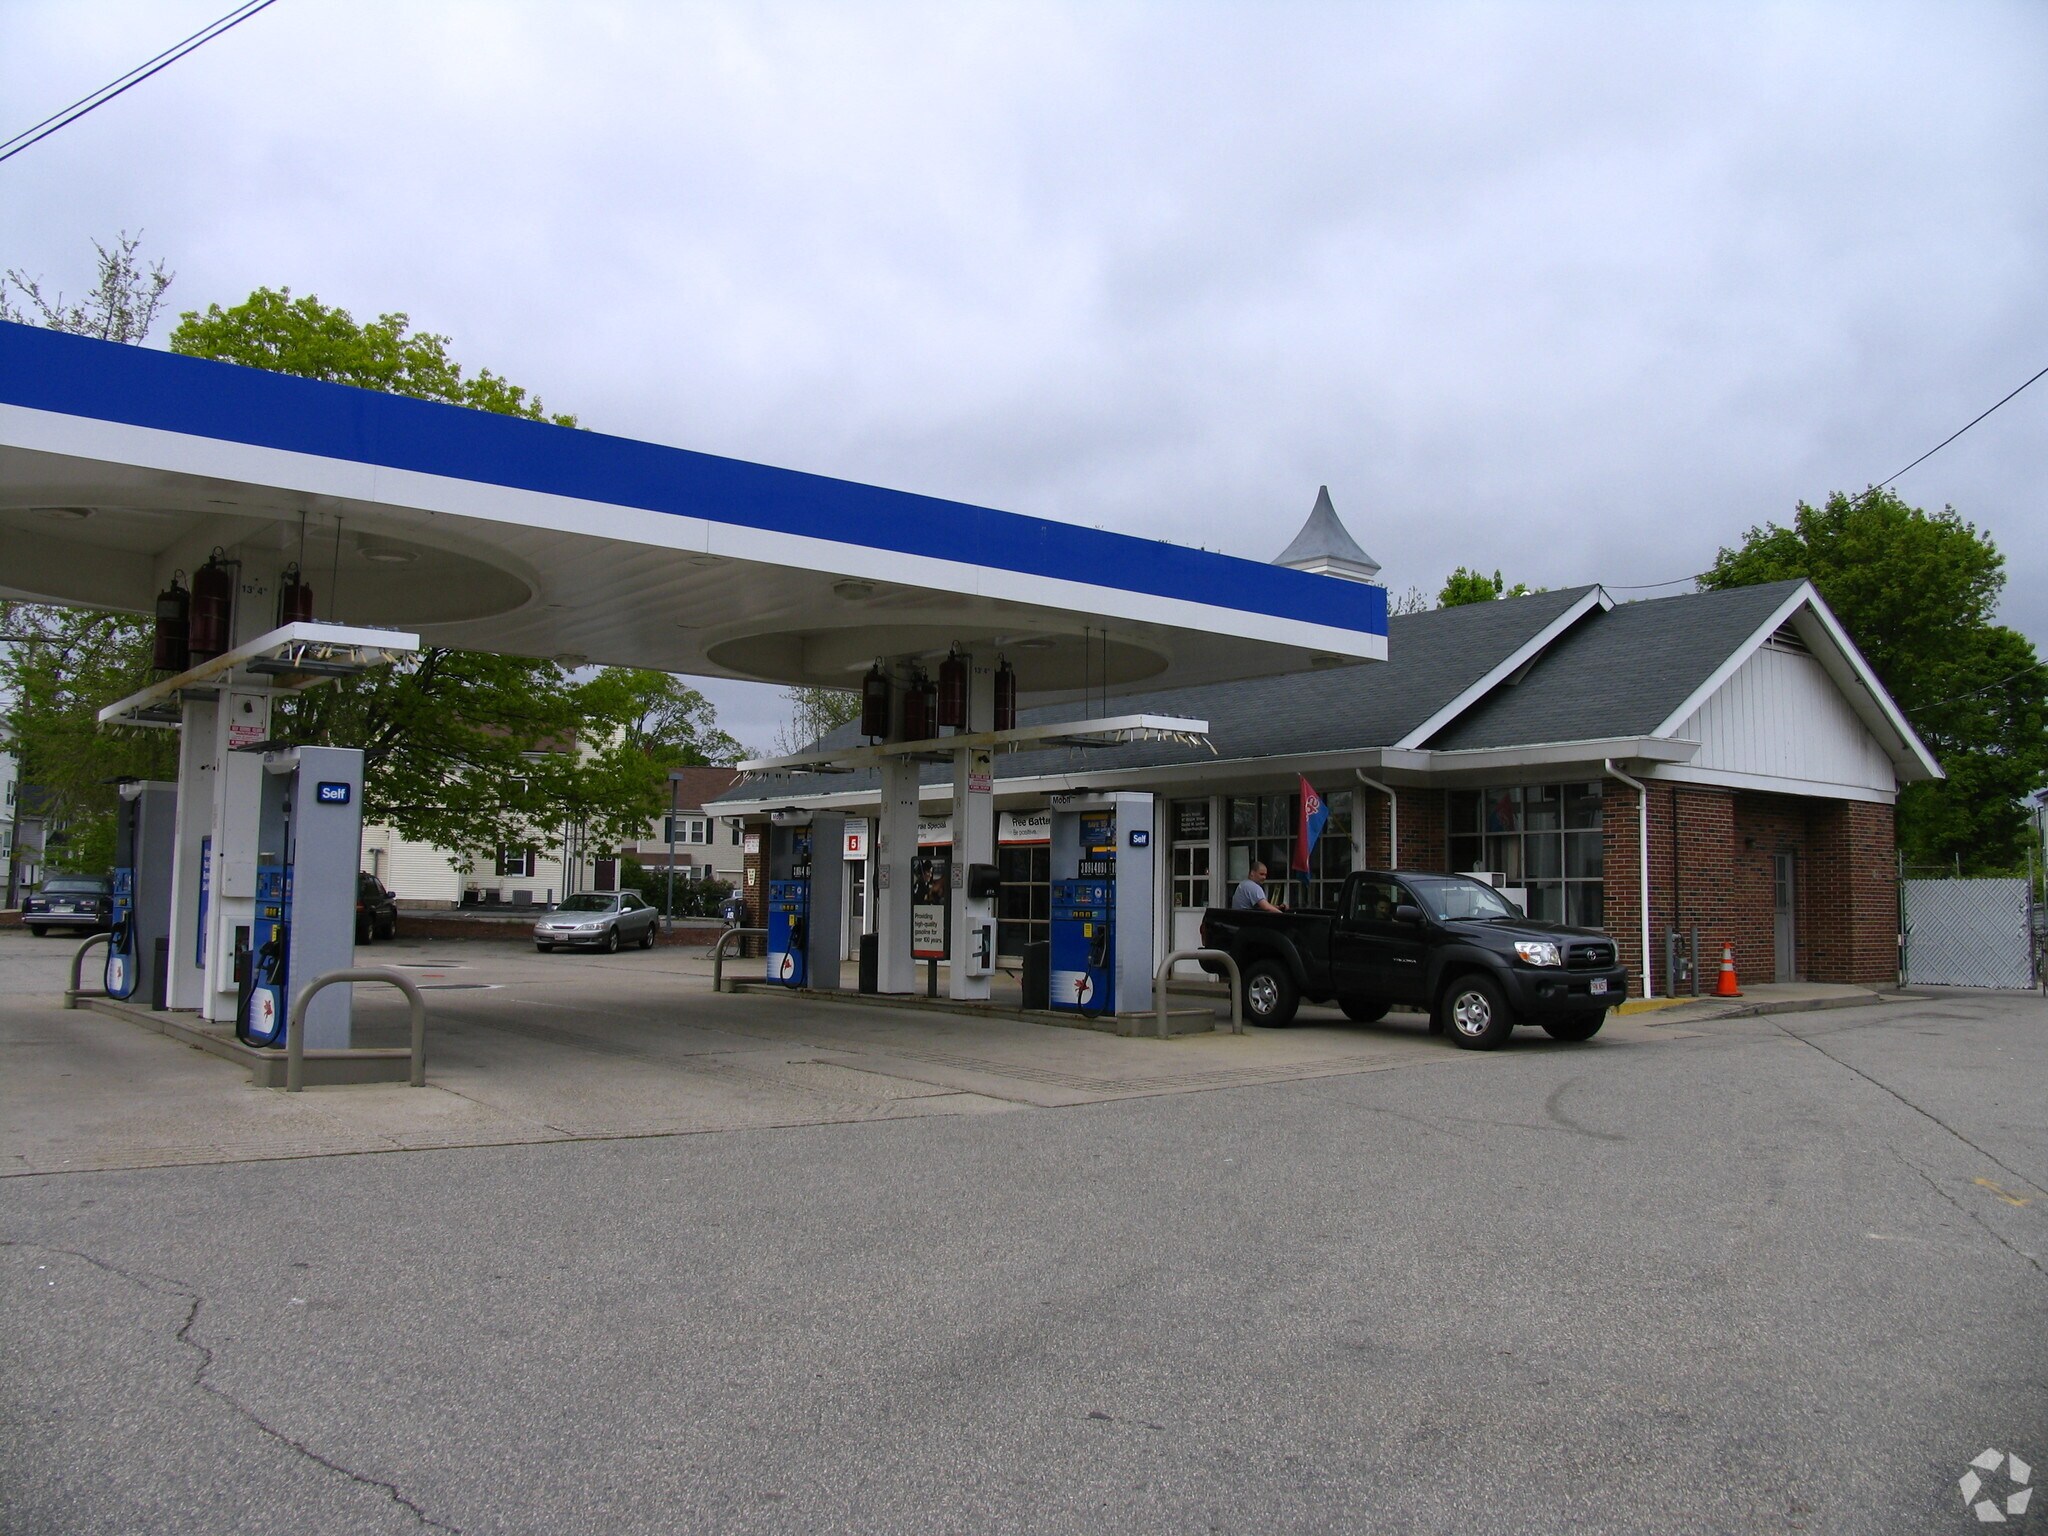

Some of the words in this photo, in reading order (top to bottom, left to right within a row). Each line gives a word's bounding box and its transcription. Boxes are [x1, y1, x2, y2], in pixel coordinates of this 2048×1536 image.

[322, 787, 346, 799] Self
[1012, 818, 1027, 827] Free
[851, 838, 857, 849] 5
[1133, 834, 1147, 843] Self
